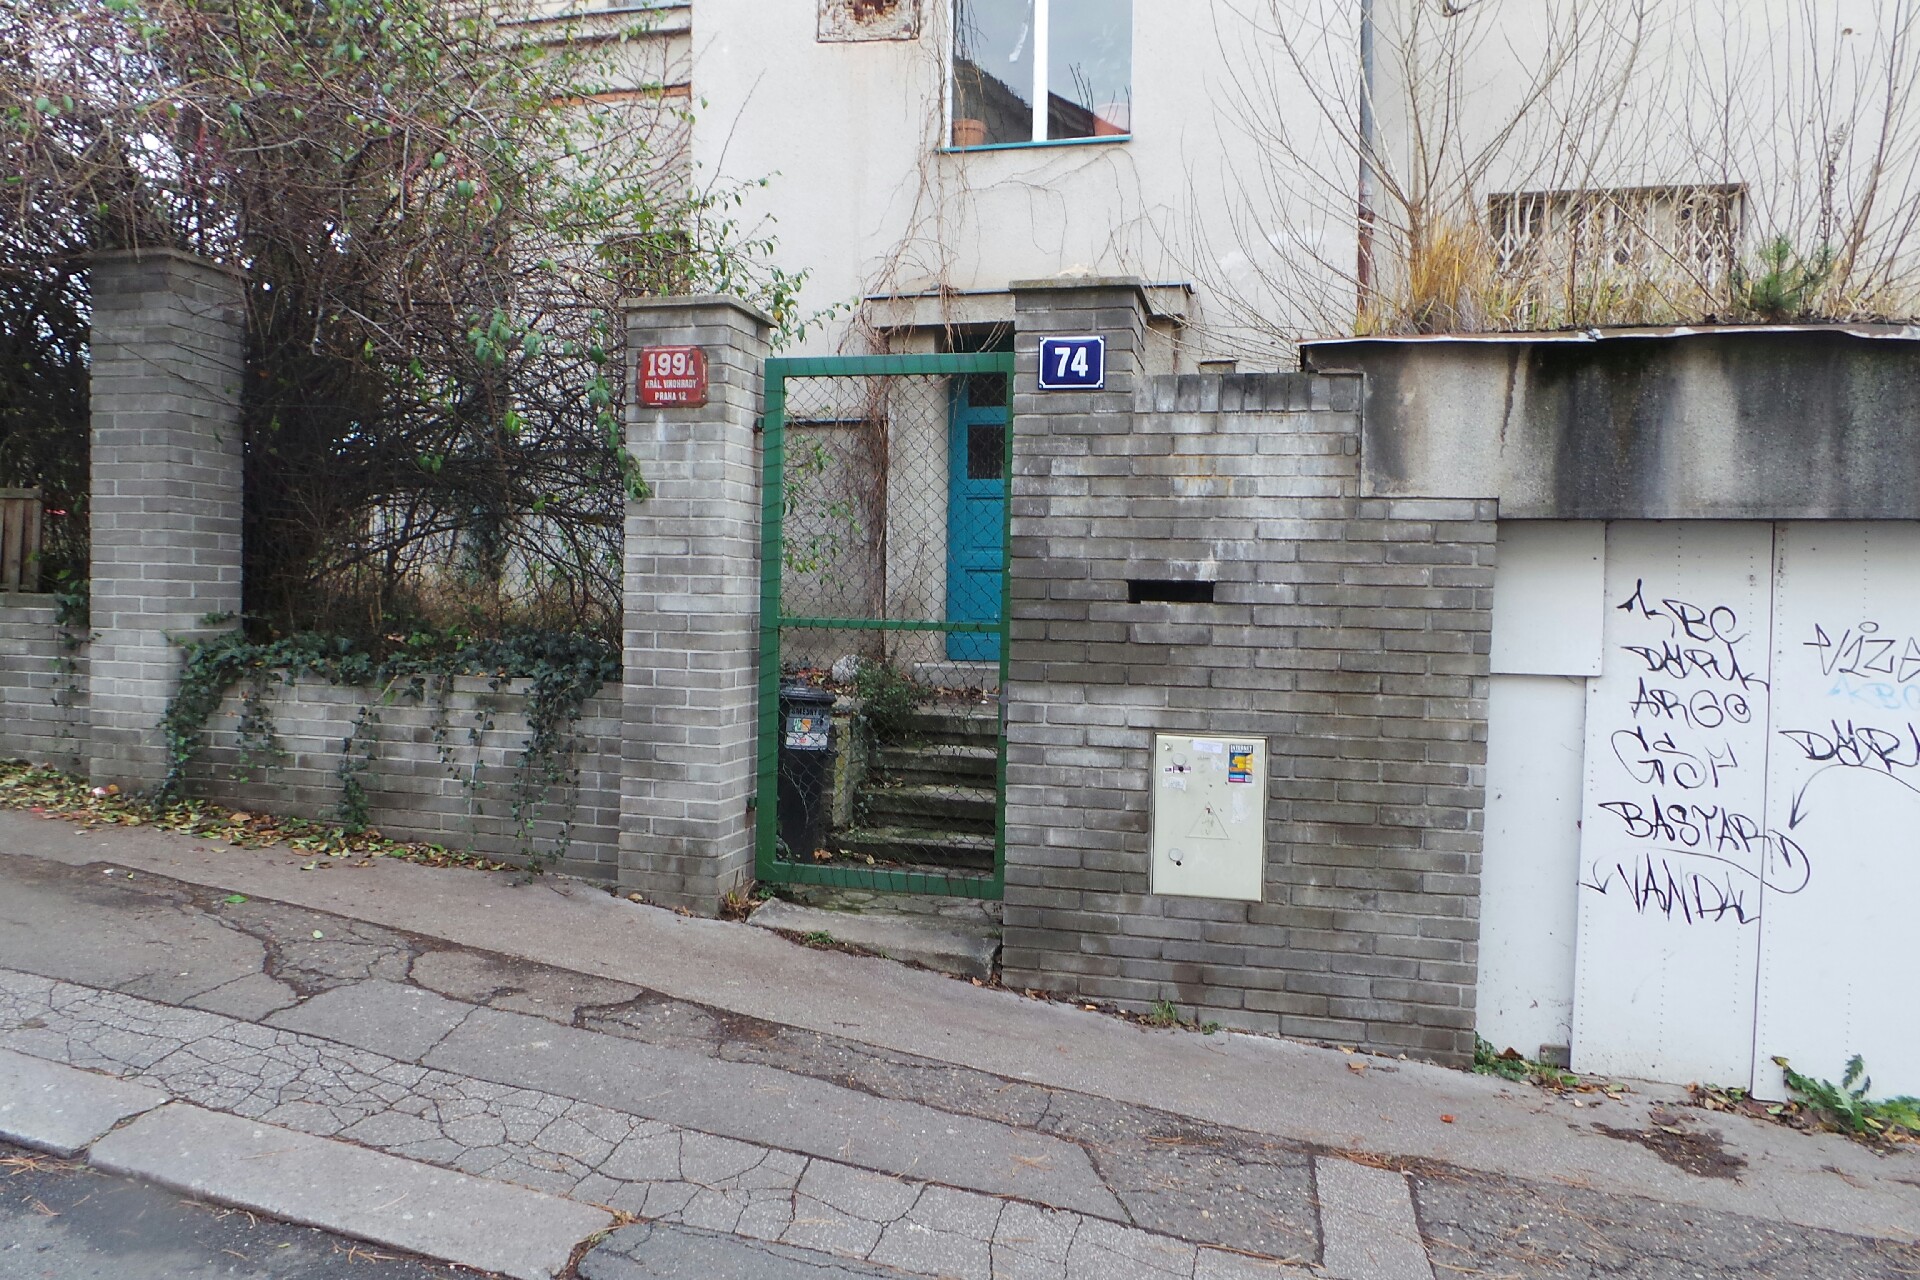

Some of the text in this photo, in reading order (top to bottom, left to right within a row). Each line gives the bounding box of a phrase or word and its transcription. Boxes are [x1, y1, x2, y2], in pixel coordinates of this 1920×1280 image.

[648, 352, 695, 376] 1991
[1054, 346, 1089, 378] 74
[654, 391, 687, 401] PRAHA 12
[1230, 744, 1253, 752] INTERNET
[1598, 794, 1811, 889] BASTARD
[1616, 852, 1760, 925] VANDAL
